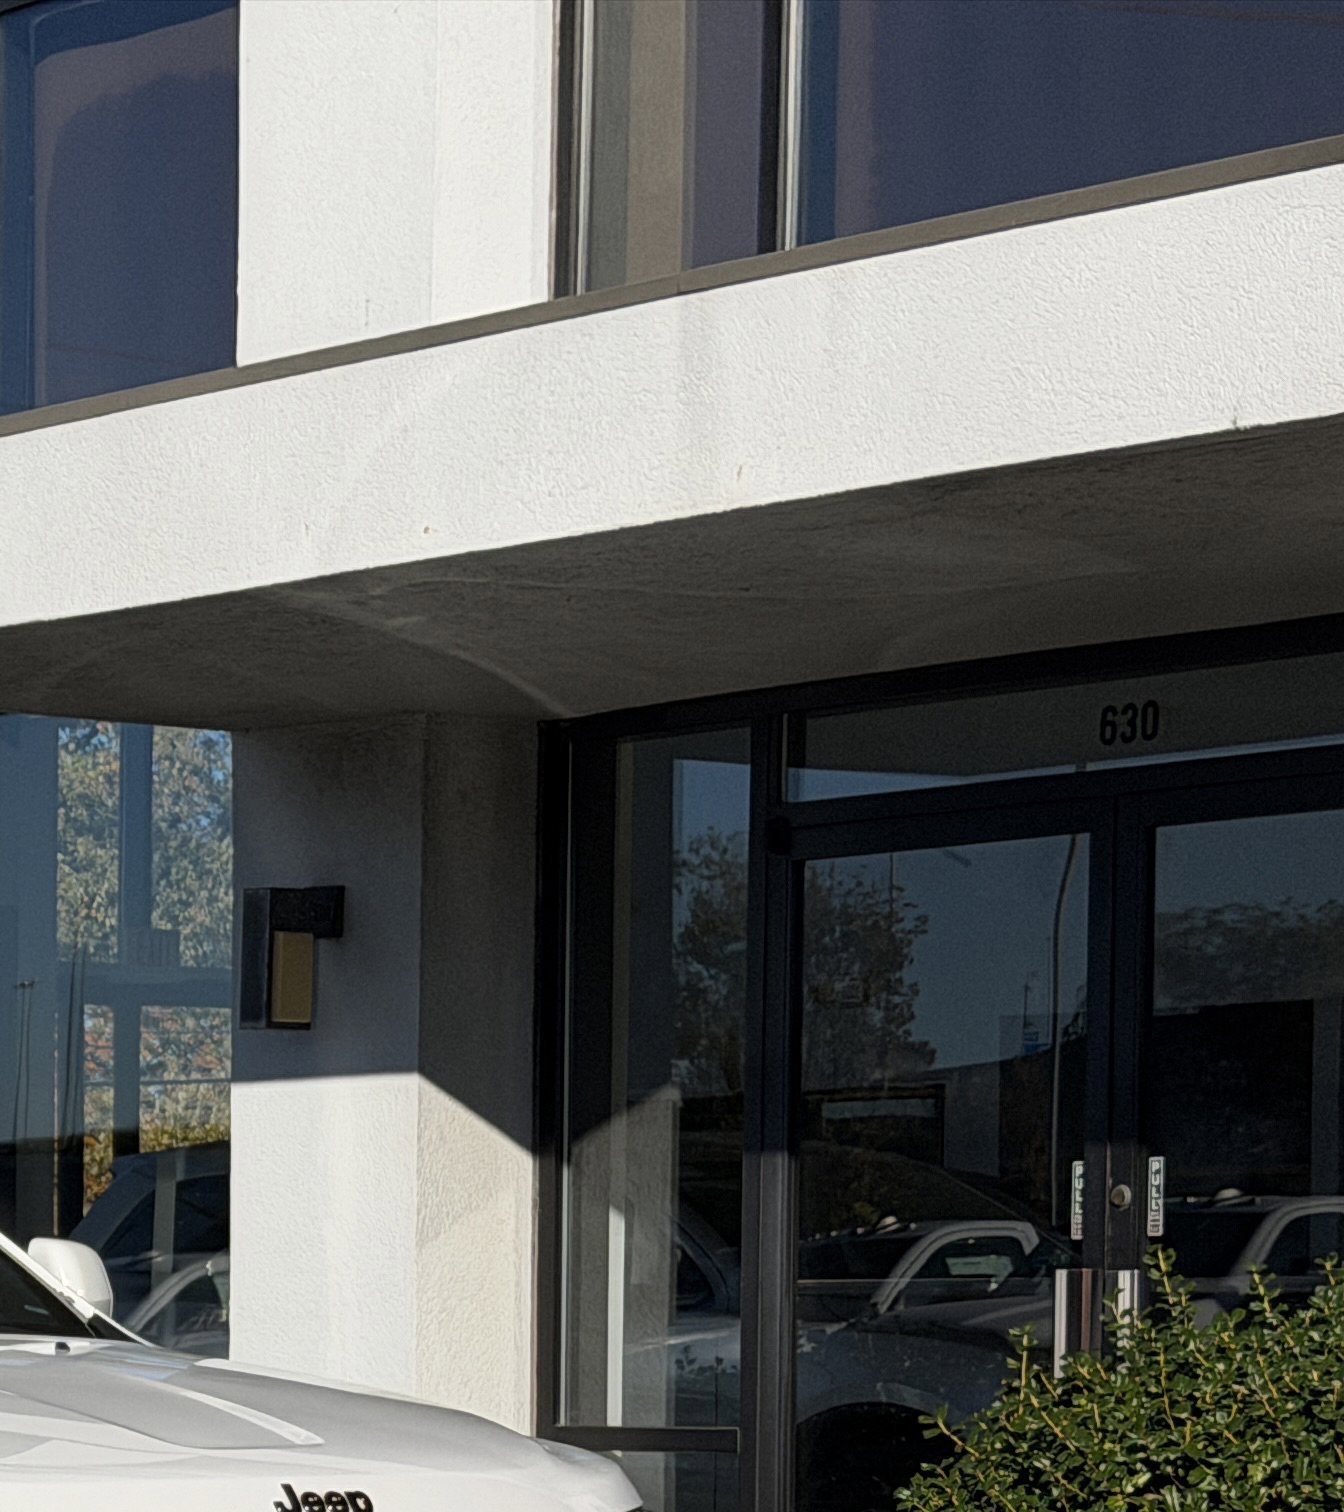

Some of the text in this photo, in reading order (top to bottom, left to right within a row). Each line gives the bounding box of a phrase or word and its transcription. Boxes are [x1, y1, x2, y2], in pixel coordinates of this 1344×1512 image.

[1100, 699, 1160, 746] 630
[1075, 1164, 1084, 1214] PULL
[1151, 1160, 1161, 1211] PULL
